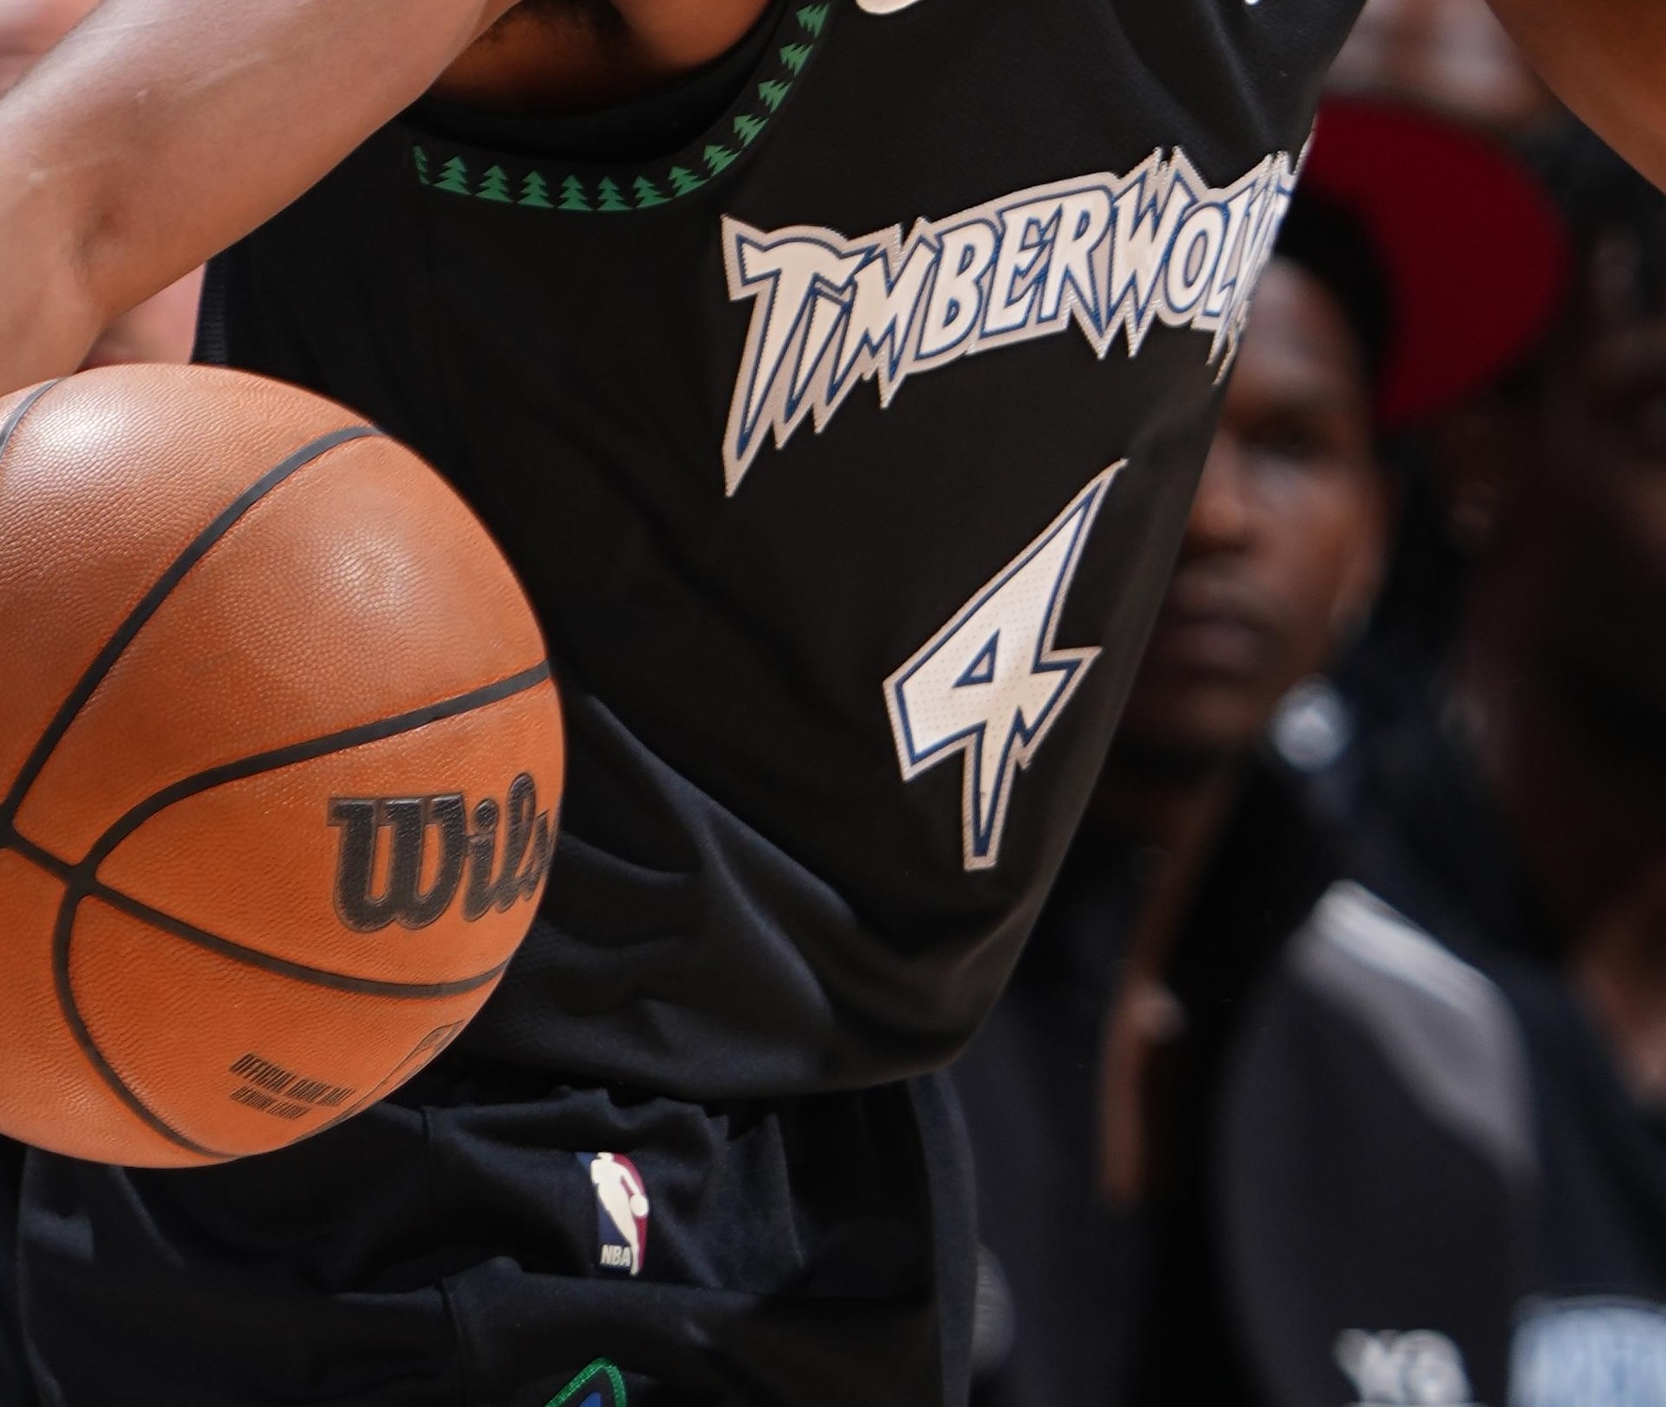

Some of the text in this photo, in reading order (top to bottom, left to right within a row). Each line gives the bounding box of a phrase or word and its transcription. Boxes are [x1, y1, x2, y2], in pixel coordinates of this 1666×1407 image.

[882, 459, 1129, 872] 4
[326, 772, 557, 934] Wils
[599, 1244, 631, 1267] NBA
